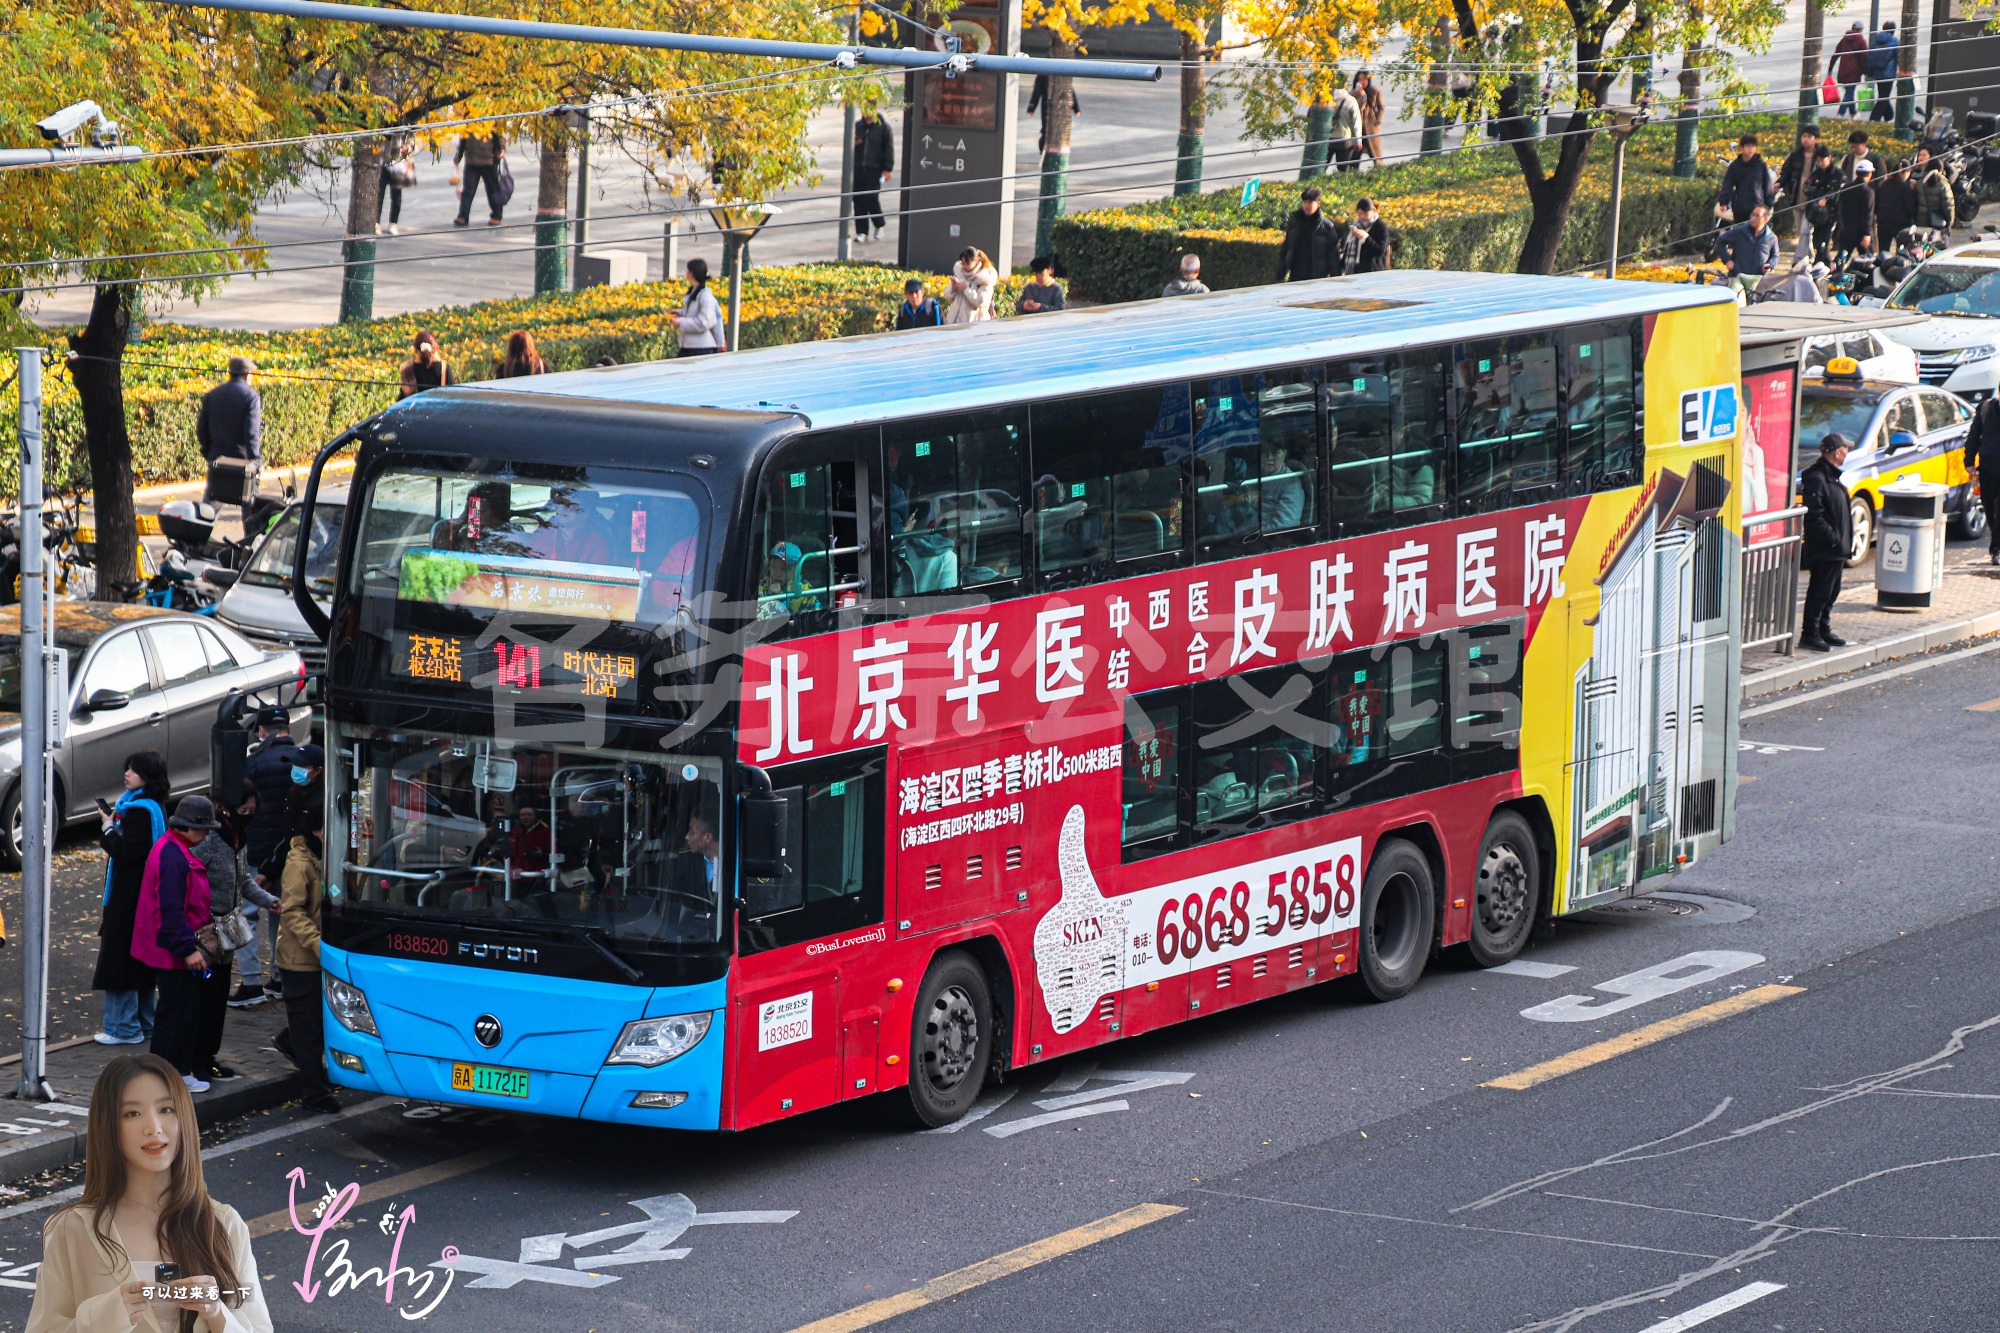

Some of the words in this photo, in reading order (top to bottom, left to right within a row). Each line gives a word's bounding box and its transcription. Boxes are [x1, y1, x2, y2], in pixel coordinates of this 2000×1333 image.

[956, 138, 966, 151] A
[955, 158, 965, 171] B
[1230, 512, 1567, 668] 皮肤病医院
[1108, 580, 1209, 638] 中西医
[408, 655, 462, 682] 枢纽站
[494, 641, 540, 689] 141
[563, 650, 636, 679] 时代庄园
[581, 674, 618, 699] 北站
[755, 604, 1086, 763] 北京华医
[900, 801, 1025, 852] (海淀区西四环北路29号)
[1156, 880, 1250, 966] 6868
[1267, 853, 1356, 937] 5858
[386, 933, 449, 956] 1838520
[1062, 916, 1105, 948] SKIN
[458, 941, 538, 964] FOTON
[777, 998, 808, 1014] 北京公交
[764, 1018, 809, 1045] 1838520
